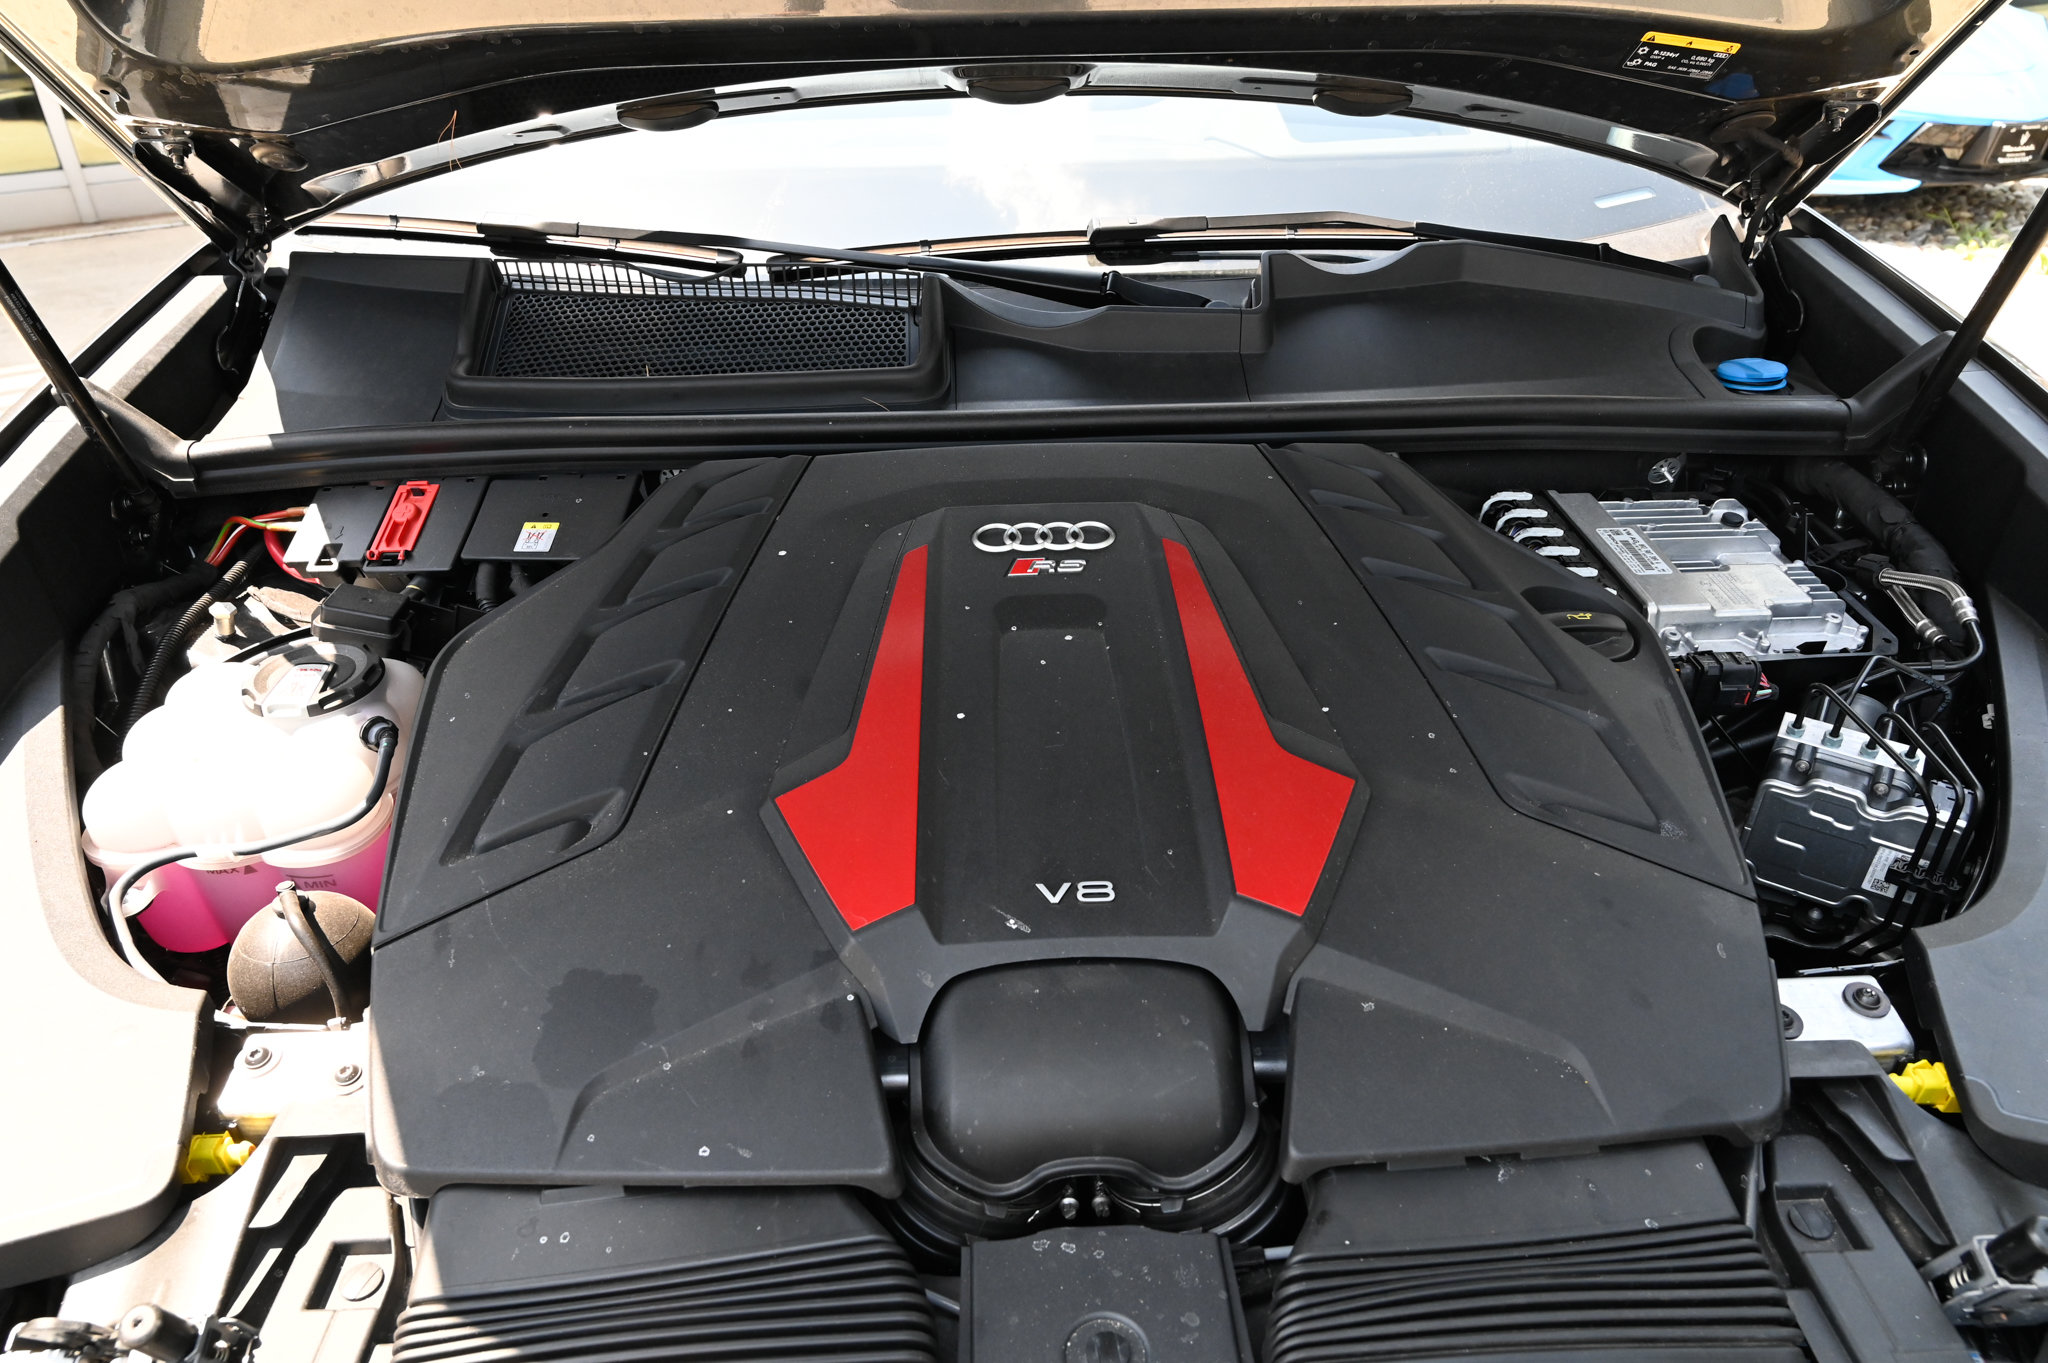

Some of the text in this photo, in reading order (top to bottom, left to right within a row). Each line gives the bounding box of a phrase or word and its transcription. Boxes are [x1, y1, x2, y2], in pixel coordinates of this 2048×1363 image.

[1021, 558, 1087, 574] RS
[304, 879, 336, 889] MIN
[1035, 881, 1115, 904] V8
